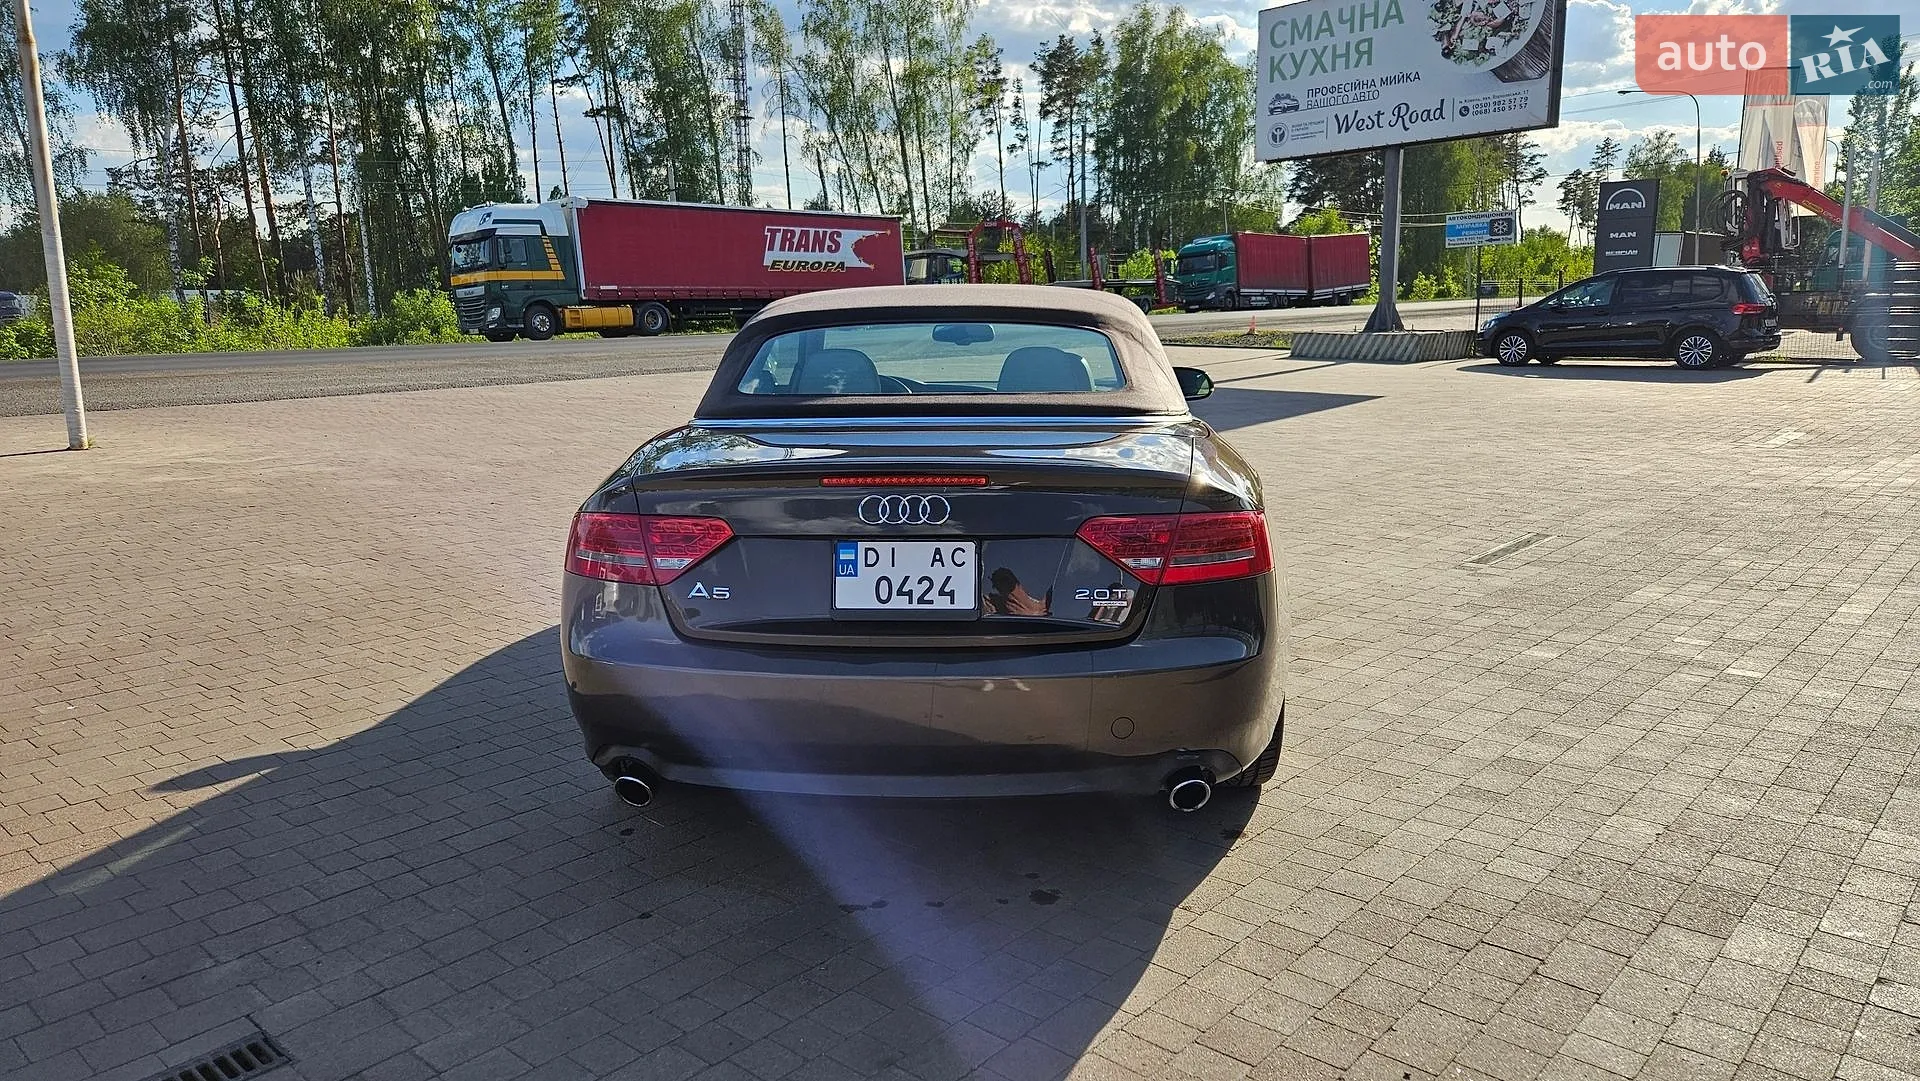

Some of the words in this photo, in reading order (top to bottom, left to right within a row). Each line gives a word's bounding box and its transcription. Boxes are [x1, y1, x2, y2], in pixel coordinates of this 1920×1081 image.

[1269, 0, 1405, 49] СМАЧНА
[1269, 37, 1374, 83] КУХНЯ
[1307, 78, 1377, 99] ПРОФЕСІЙНА
[1379, 71, 1421, 88] МИЙКА
[1306, 93, 1350, 110] ВАШОГО
[1352, 89, 1380, 103] АВТО
[1334, 109, 1385, 135] West
[1388, 98, 1446, 132] Road
[1609, 201, 1643, 211] MAN
[765, 227, 843, 254] TRANS
[1609, 231, 1637, 239] MAN
[767, 259, 847, 273] EUROPA
[864, 547, 895, 568] DI
[930, 547, 966, 568] AC
[839, 564, 855, 576] UA
[687, 581, 731, 600] A5
[874, 575, 956, 605] 0424
